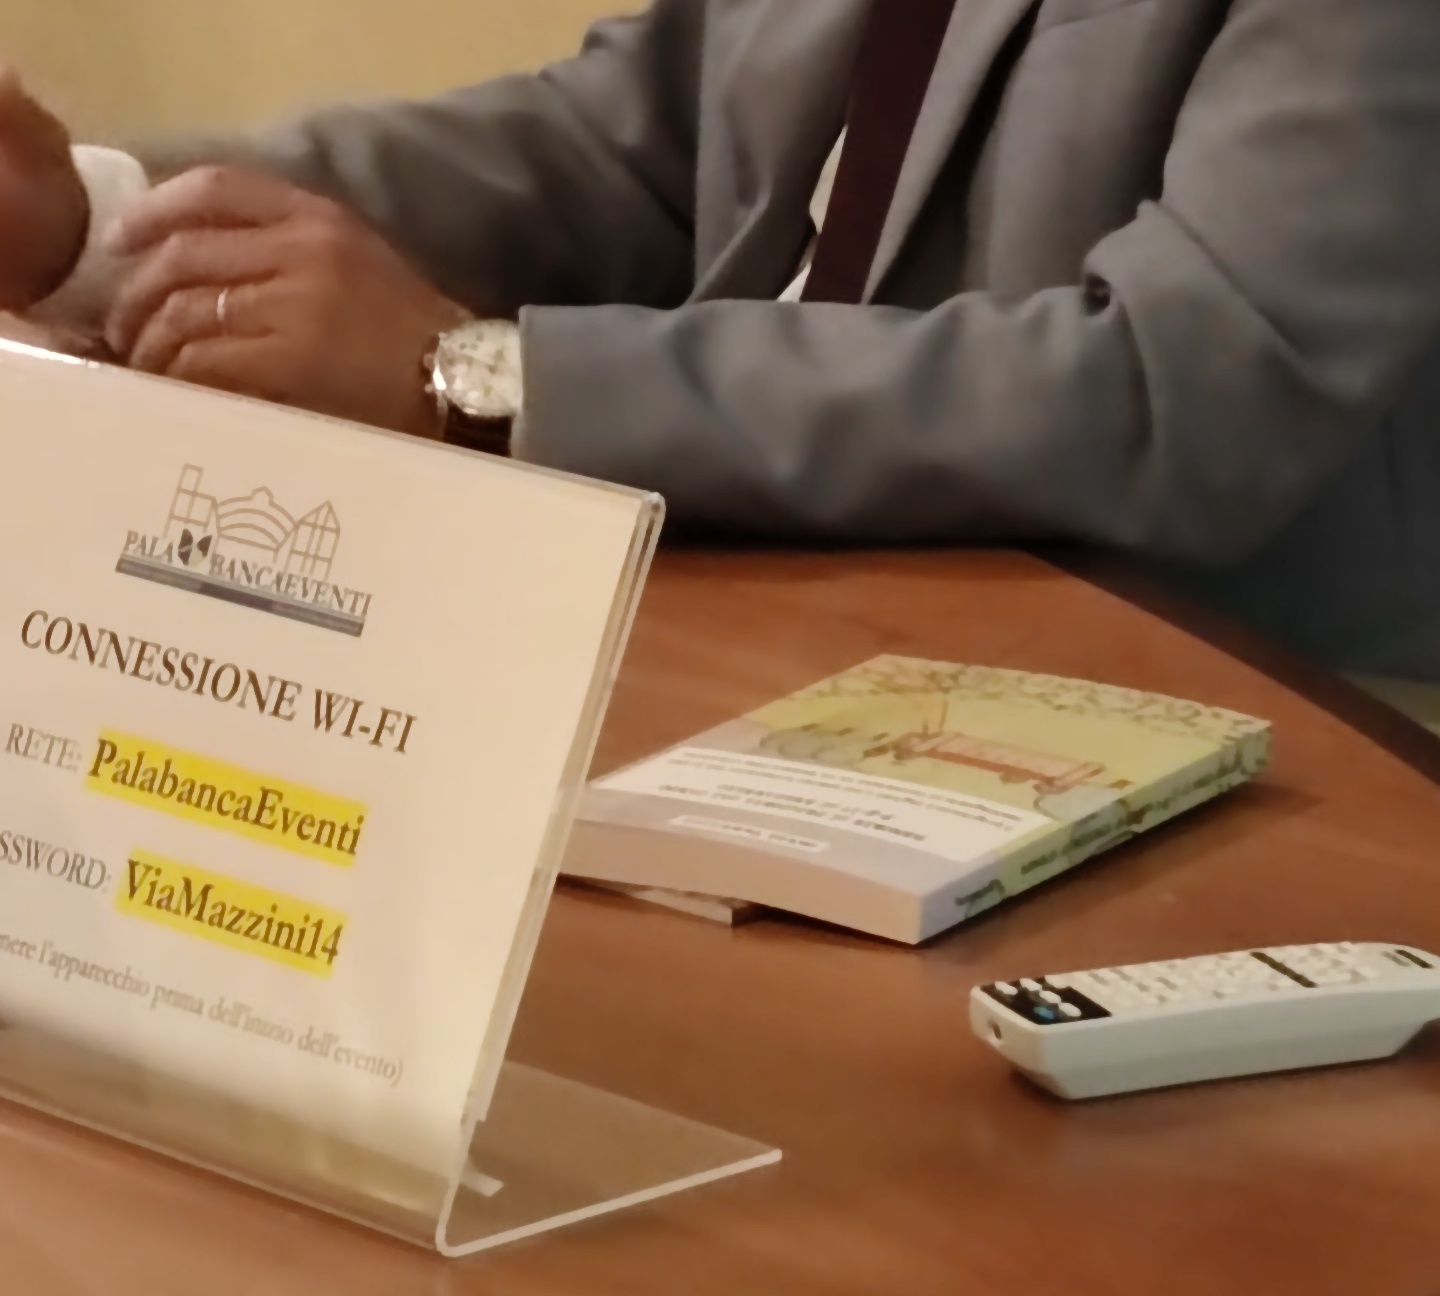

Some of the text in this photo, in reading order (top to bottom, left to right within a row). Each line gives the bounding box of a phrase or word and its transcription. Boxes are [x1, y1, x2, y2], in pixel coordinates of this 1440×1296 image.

[122, 529, 373, 616] PALA BANCAEVENTI
[21, 609, 417, 754] CONNESSIONE WI-FI
[4, 723, 365, 856] RETE: PalabancaEventi
[126, 858, 344, 966] ViaMazzini14
[39, 939, 151, 997] l'apparecchio
[149, 983, 204, 1011] prima
